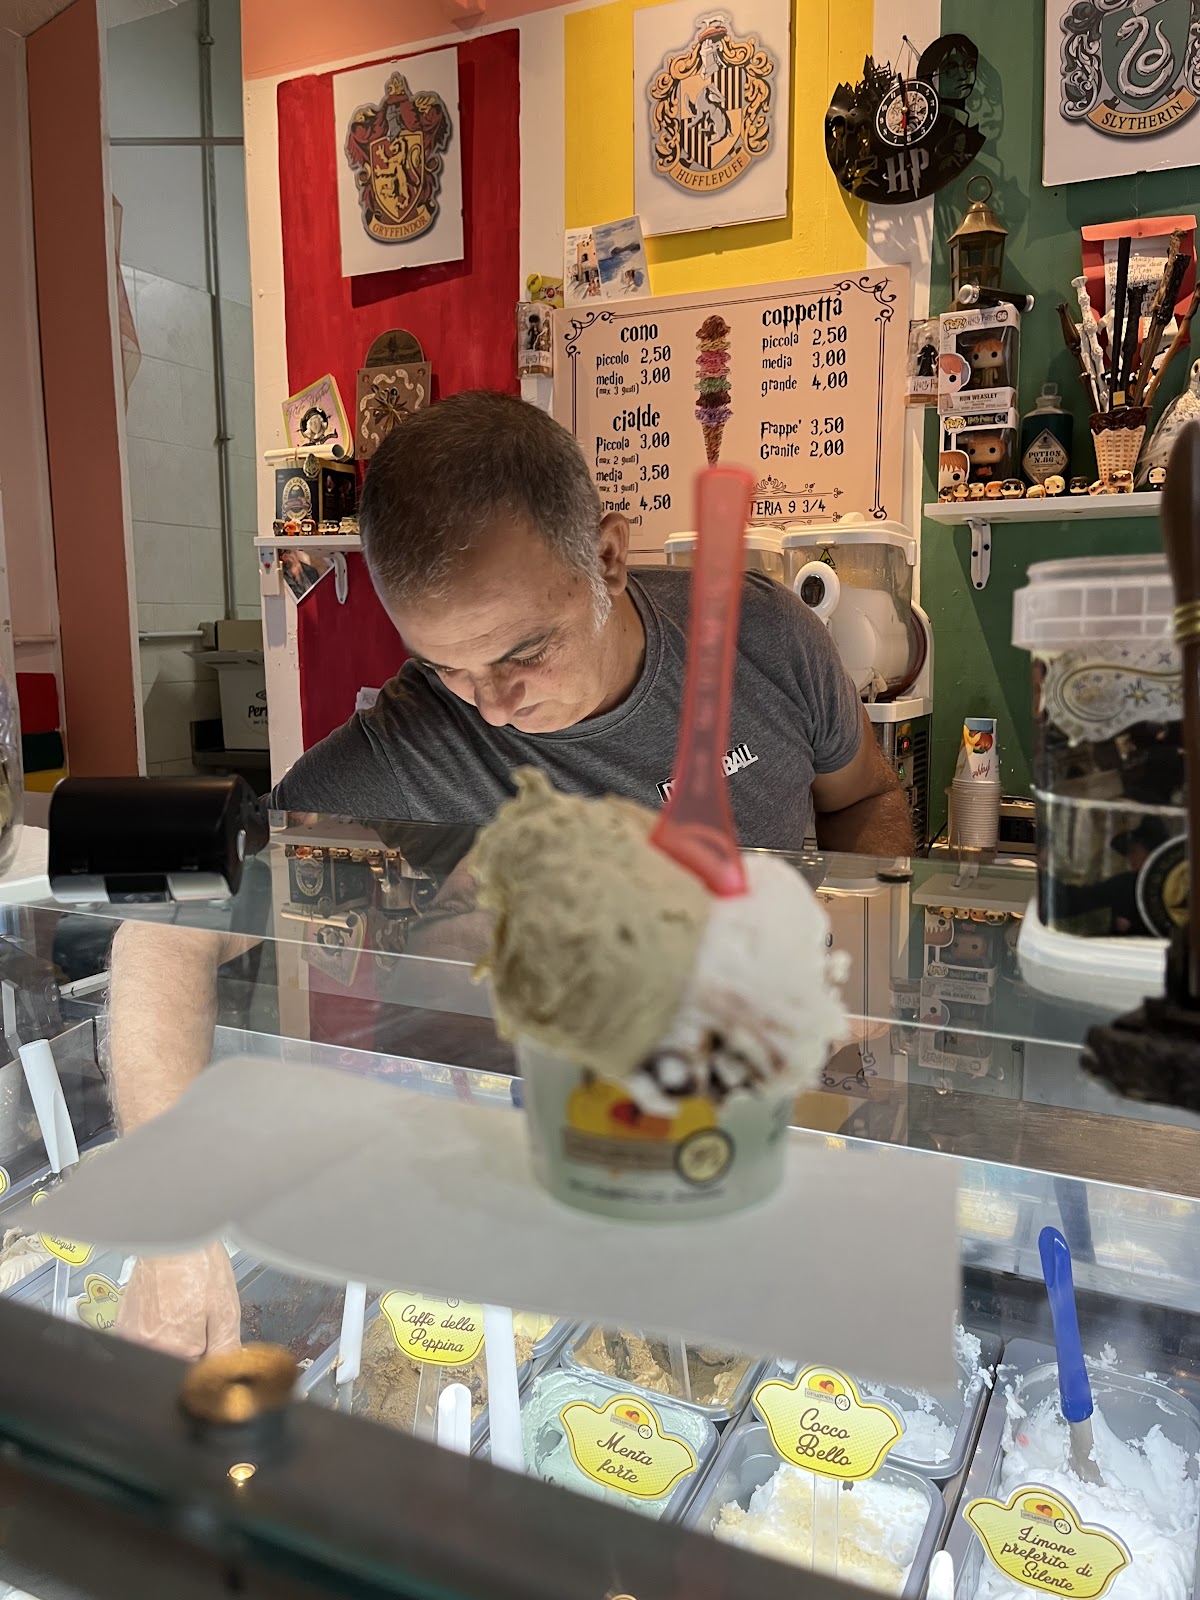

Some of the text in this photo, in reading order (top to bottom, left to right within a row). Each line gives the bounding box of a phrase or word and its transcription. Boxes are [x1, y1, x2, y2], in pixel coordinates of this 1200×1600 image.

[1101, 100, 1184, 130] SLYTHERIN
[676, 156, 744, 186] HUFFLEPUFF
[372, 216, 428, 237] GRYFFINDOR
[762, 296, 843, 333] coppetta
[620, 324, 659, 343] cono
[761, 325, 848, 354] piccola 2,50
[596, 345, 672, 370] piccolo 2,50
[762, 348, 847, 369] media 3,00
[596, 366, 671, 386] medio 3,00
[761, 370, 848, 398] grande 4,00
[614, 386, 619, 395] 3
[972, 393, 998, 401] WEASLEY
[612, 403, 661, 432] cialde
[810, 416, 845, 436] 3,50
[596, 431, 670, 455] Piccola 3,00
[760, 438, 845, 460] Granite 2,00
[1028, 450, 1061, 458] POTION
[613, 456, 619, 465] 2
[596, 464, 670, 482] media 3,50
[597, 484, 611, 493] max
[613, 484, 618, 493] 3
[639, 493, 671, 512] 4,50
[788, 500, 796, 513] 9
[802, 499, 827, 515] 3/4
[440, 1315, 475, 1332] della
[409, 1328, 464, 1353] Peppina
[800, 1408, 850, 1439] Cocco
[597, 1432, 653, 1466] Menta
[796, 1433, 851, 1466] Bello
[597, 1459, 639, 1484] forte
[1018, 1526, 1077, 1556] Limone
[1000, 1542, 1093, 1578] preferito di
[1021, 1561, 1075, 1591] Silente
